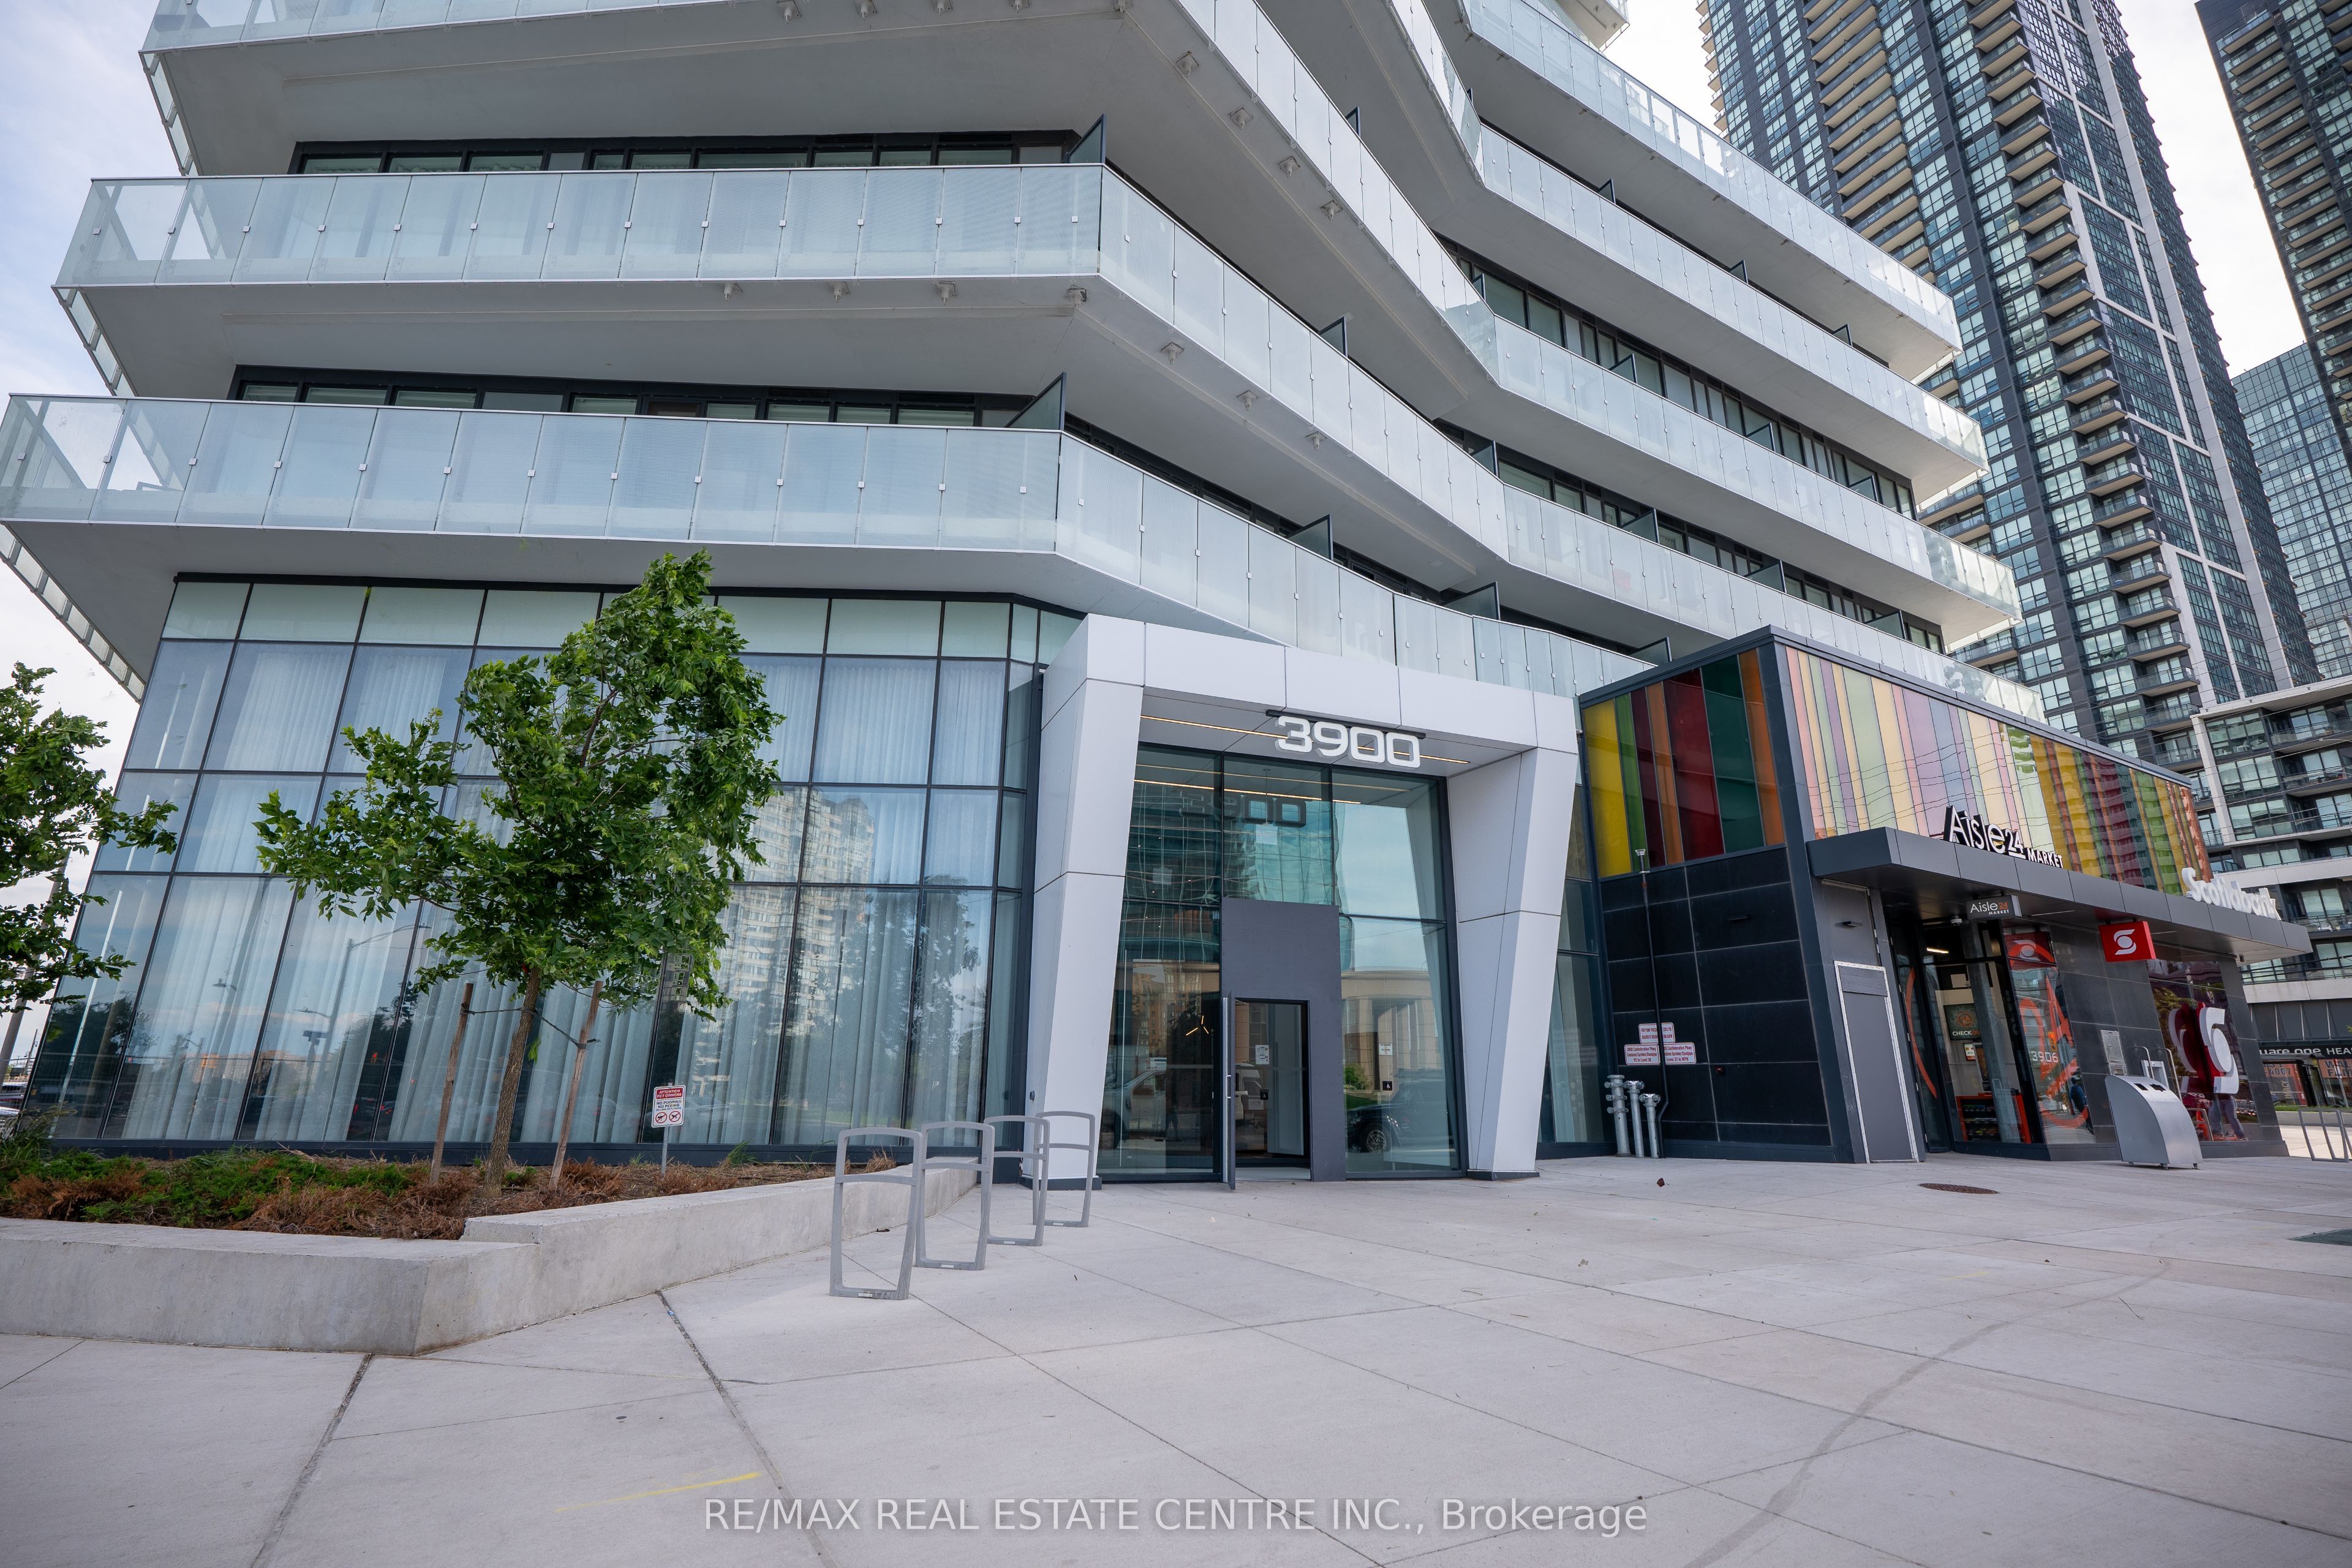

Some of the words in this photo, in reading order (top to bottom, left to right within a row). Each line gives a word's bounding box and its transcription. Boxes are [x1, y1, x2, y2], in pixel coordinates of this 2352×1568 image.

[1275, 715, 1421, 768] 3900
[2026, 847, 2064, 869] MARKET
[2182, 867, 2282, 921] Scotiabank
[2030, 1050, 2059, 1063] 3906
